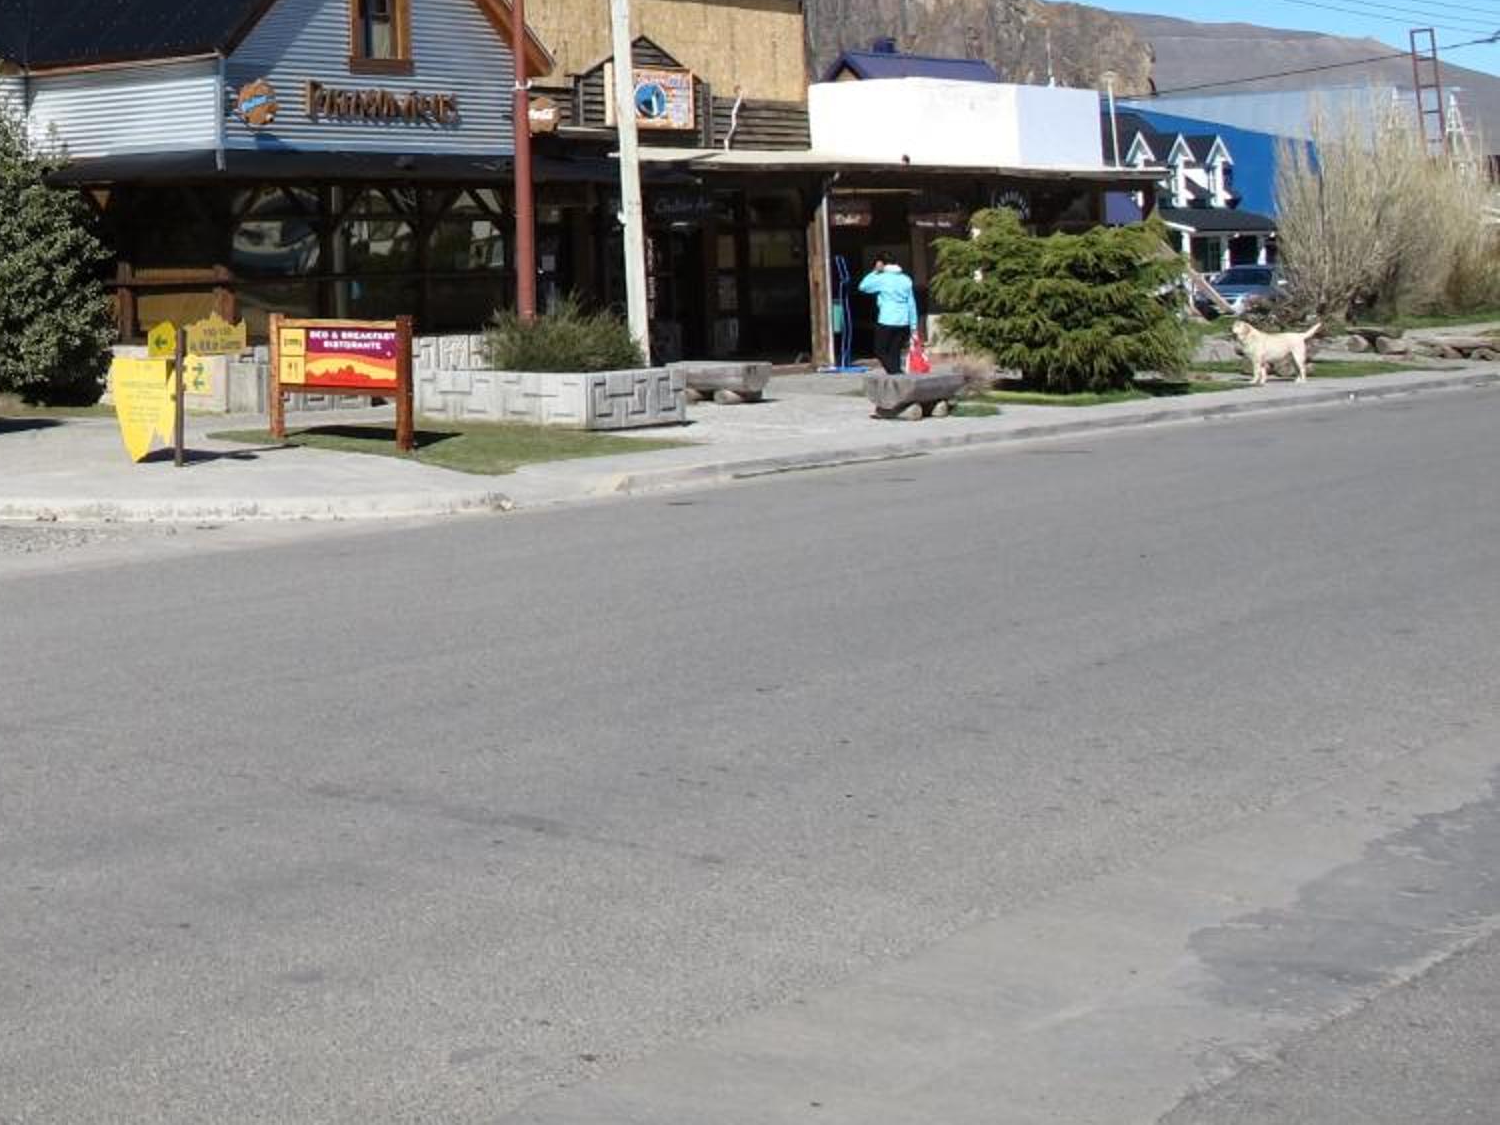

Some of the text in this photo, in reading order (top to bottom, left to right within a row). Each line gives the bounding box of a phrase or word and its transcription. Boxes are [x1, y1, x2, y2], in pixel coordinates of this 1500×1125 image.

[309, 330, 396, 340] BED & BREAKFAST
